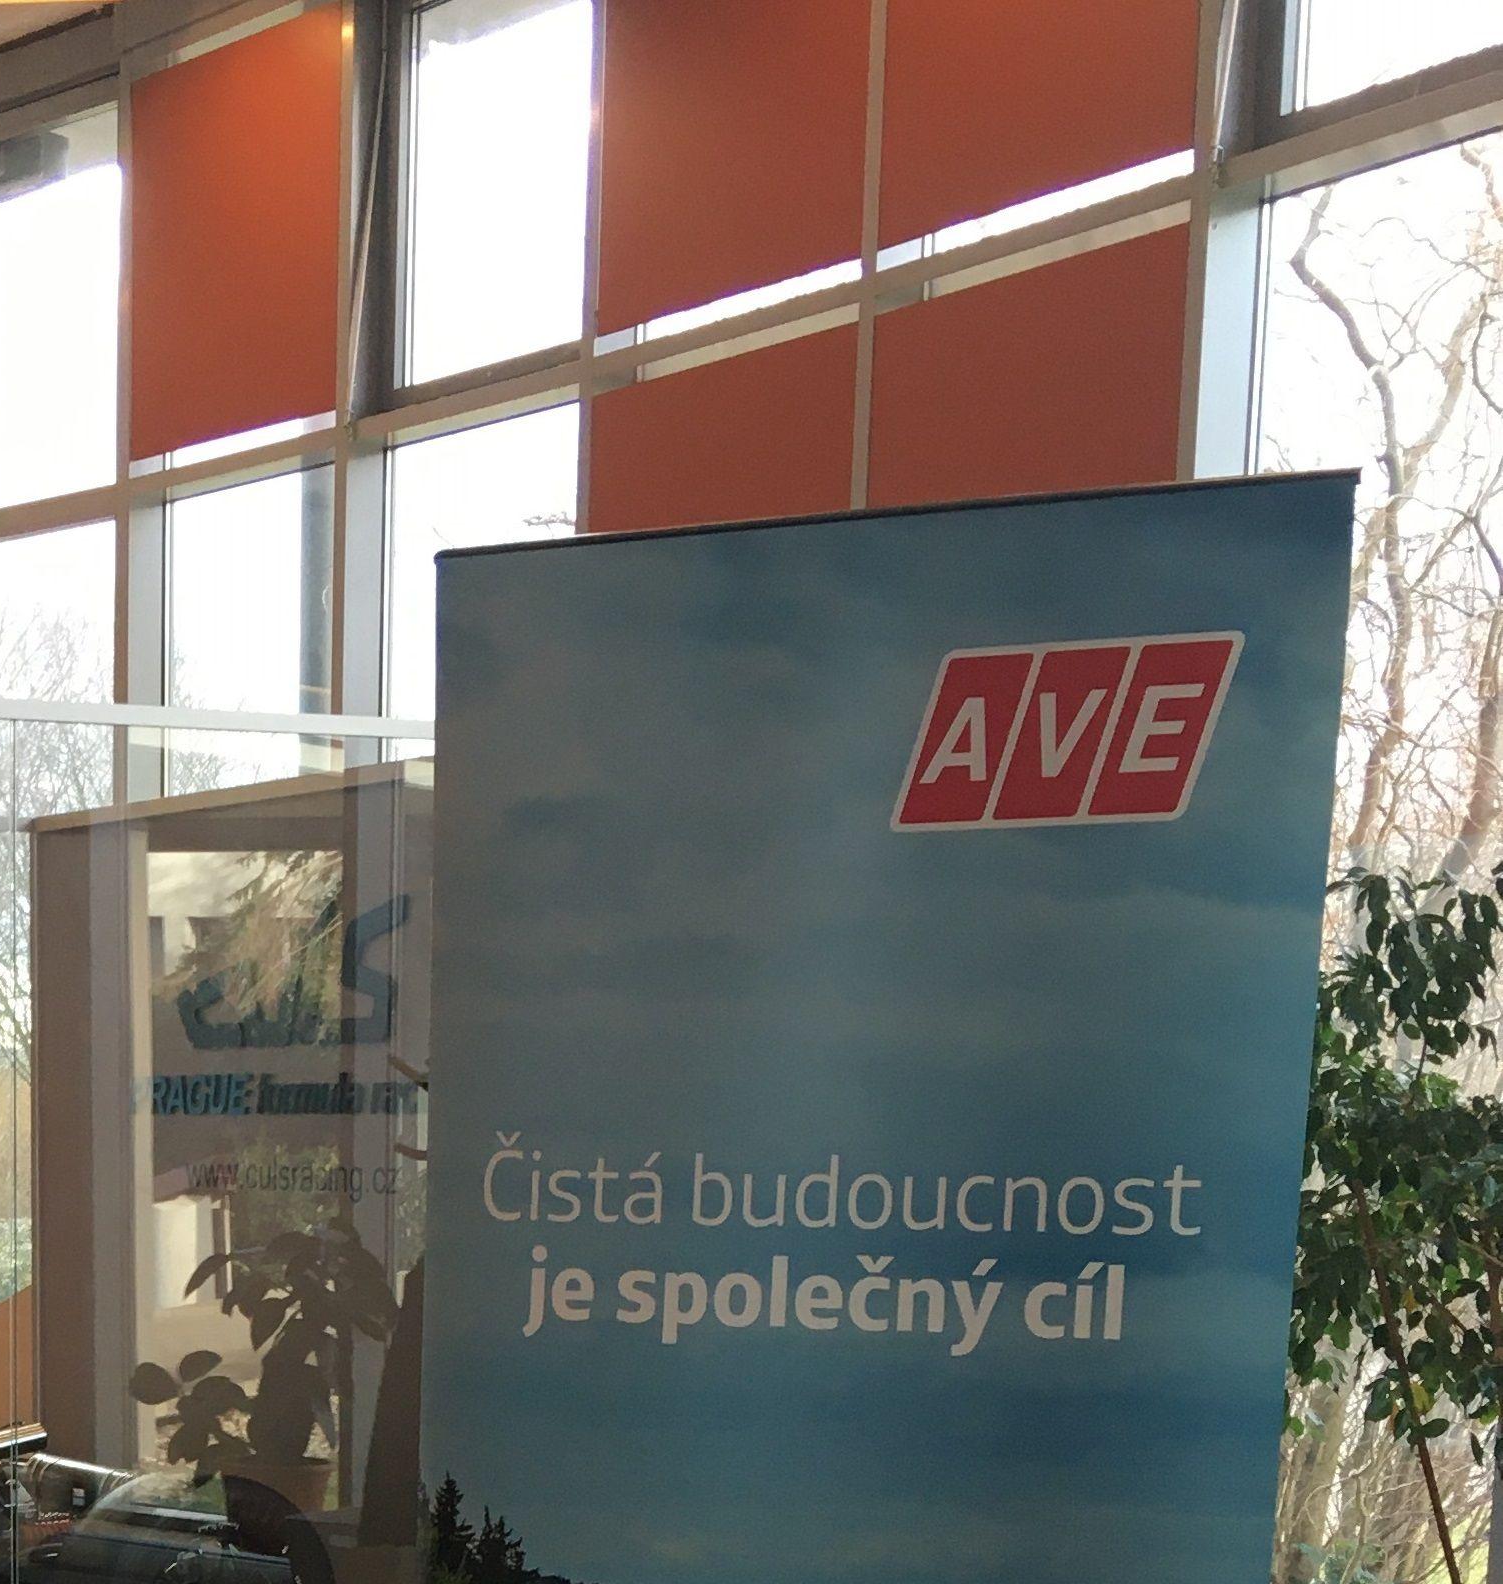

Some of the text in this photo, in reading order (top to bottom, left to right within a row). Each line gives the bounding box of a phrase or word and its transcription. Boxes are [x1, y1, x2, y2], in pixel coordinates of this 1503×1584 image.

[917, 680, 1207, 786] AVE
[188, 1160, 398, 1199] www.culsracing.cz
[483, 1131, 1203, 1238] Čistá budoucnost
[523, 1245, 1127, 1356] je společný cíl
